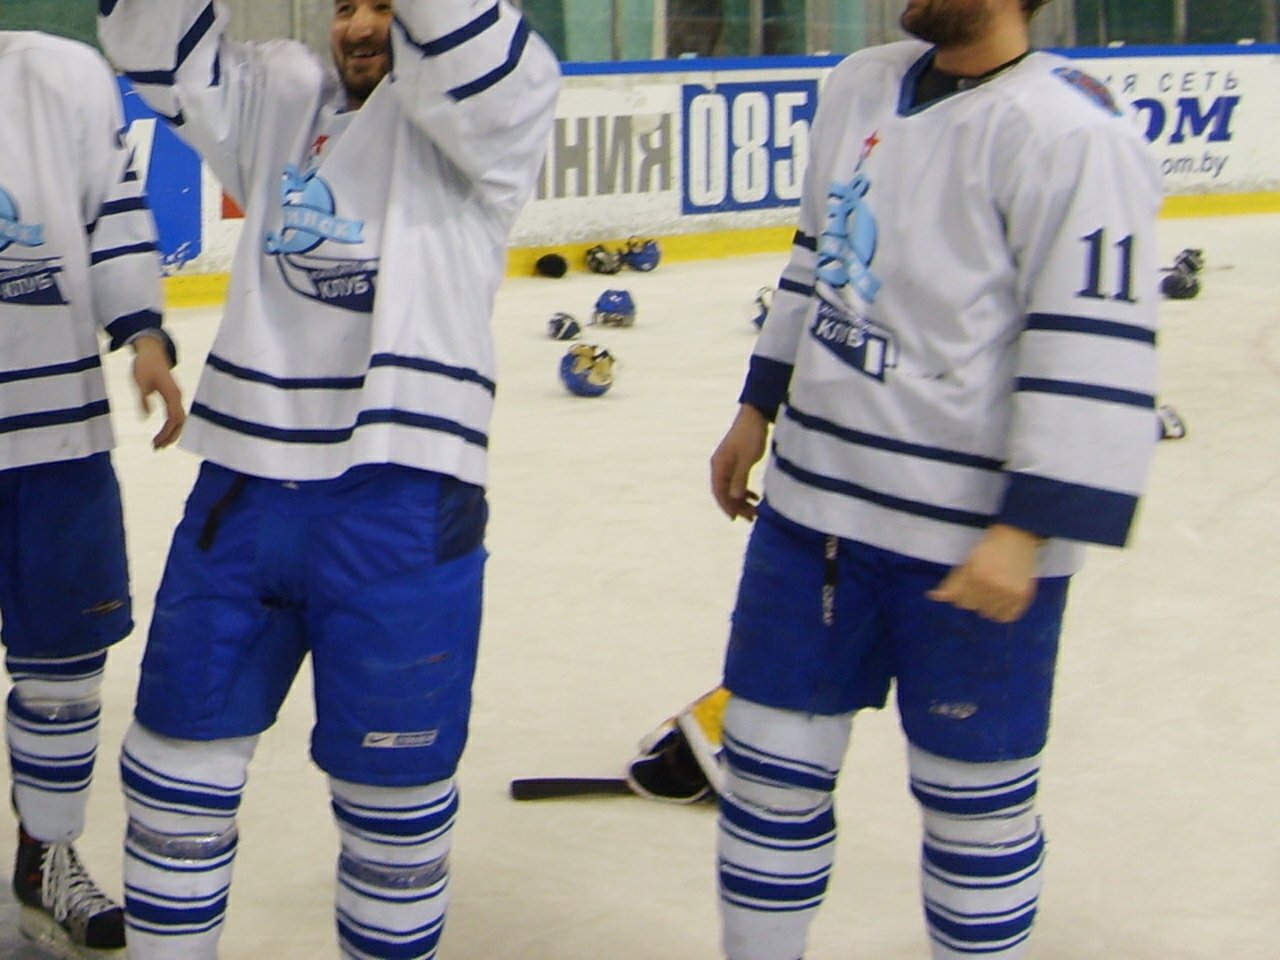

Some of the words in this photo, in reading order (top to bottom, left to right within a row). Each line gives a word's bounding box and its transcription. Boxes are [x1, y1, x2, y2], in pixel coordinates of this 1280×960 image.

[1158, 71, 1239, 92] СЕТЬ
[689, 91, 810, 207] 085
[1160, 152, 1229, 178] om.by
[1077, 227, 1138, 303] 11
